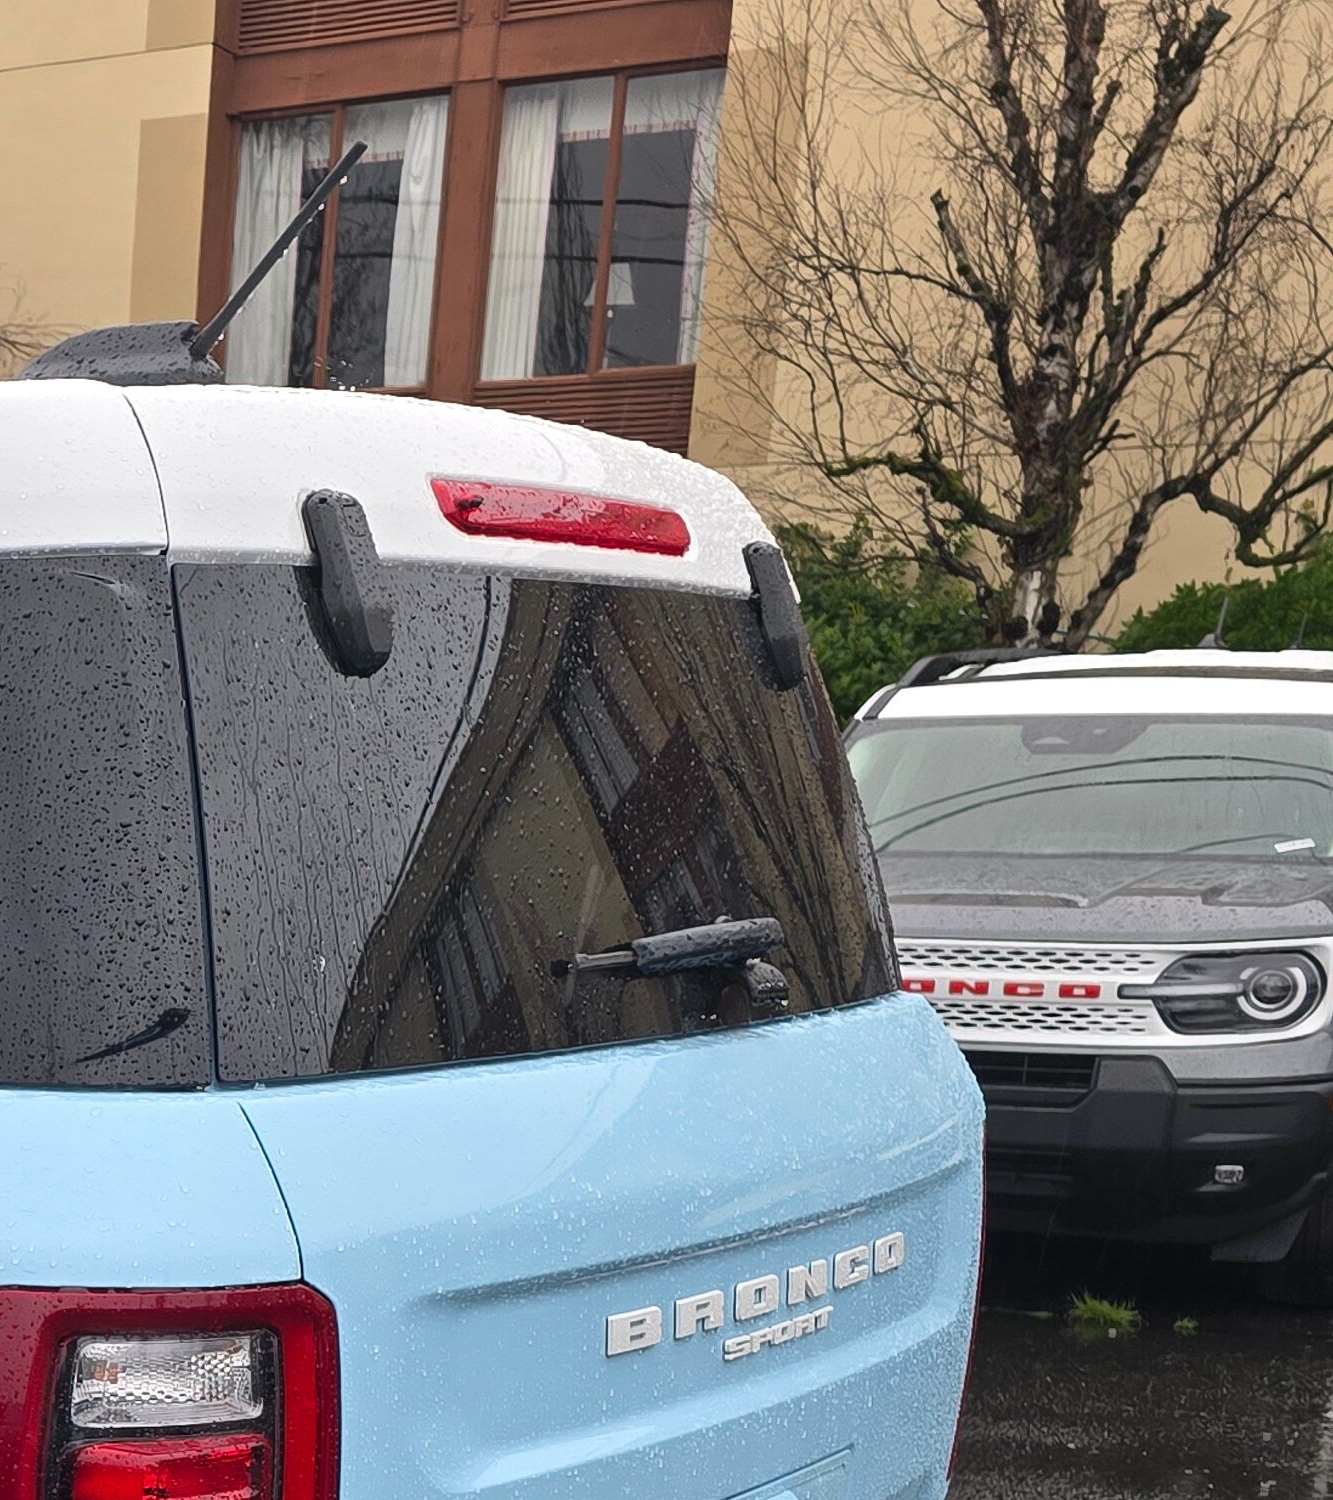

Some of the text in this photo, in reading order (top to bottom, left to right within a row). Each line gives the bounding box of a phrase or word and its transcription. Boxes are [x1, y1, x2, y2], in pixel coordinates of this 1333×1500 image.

[902, 979, 1102, 999] ONCO
[605, 1231, 906, 1357] BRONCO
[721, 1305, 834, 1361] SPORT
